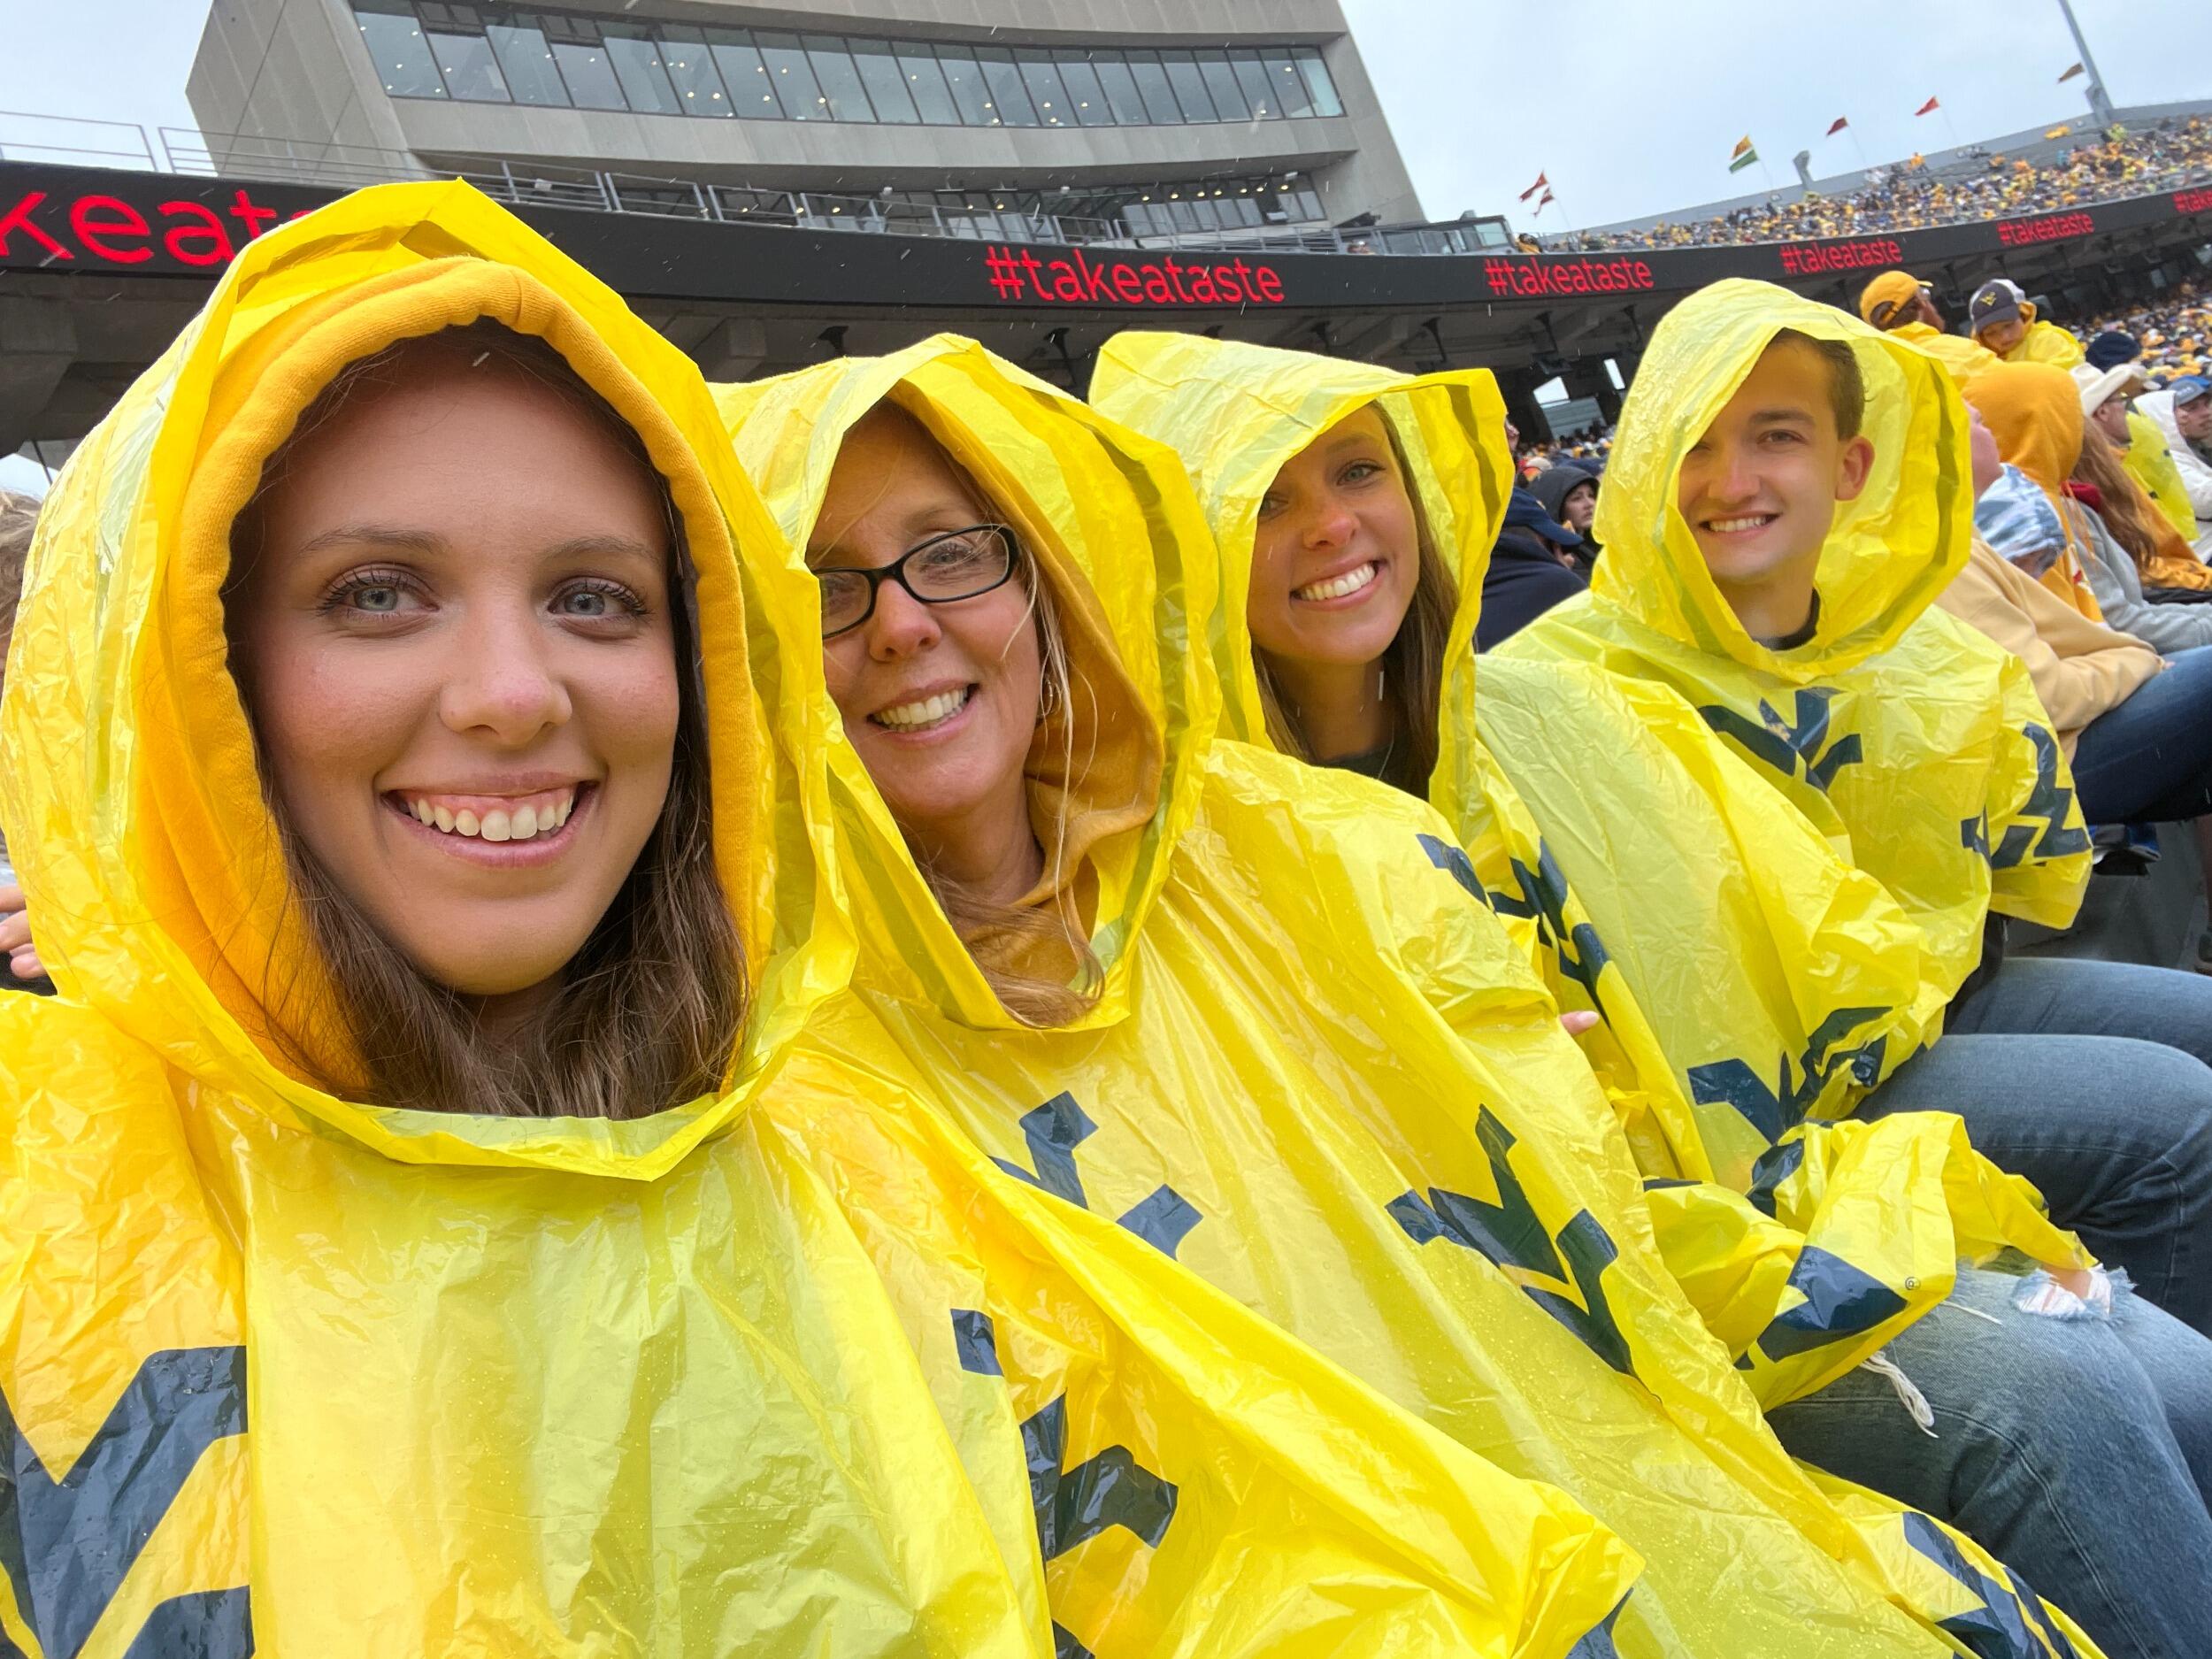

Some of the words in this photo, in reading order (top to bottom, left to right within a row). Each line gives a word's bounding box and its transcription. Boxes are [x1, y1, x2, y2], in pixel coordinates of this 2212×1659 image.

[0, 189, 316, 266] keat
[1997, 214, 2093, 246] #takeataste
[986, 245, 1285, 304] #takeataste
[1780, 239, 1902, 274] #takeataste
[1485, 257, 1654, 296] #takeataste
